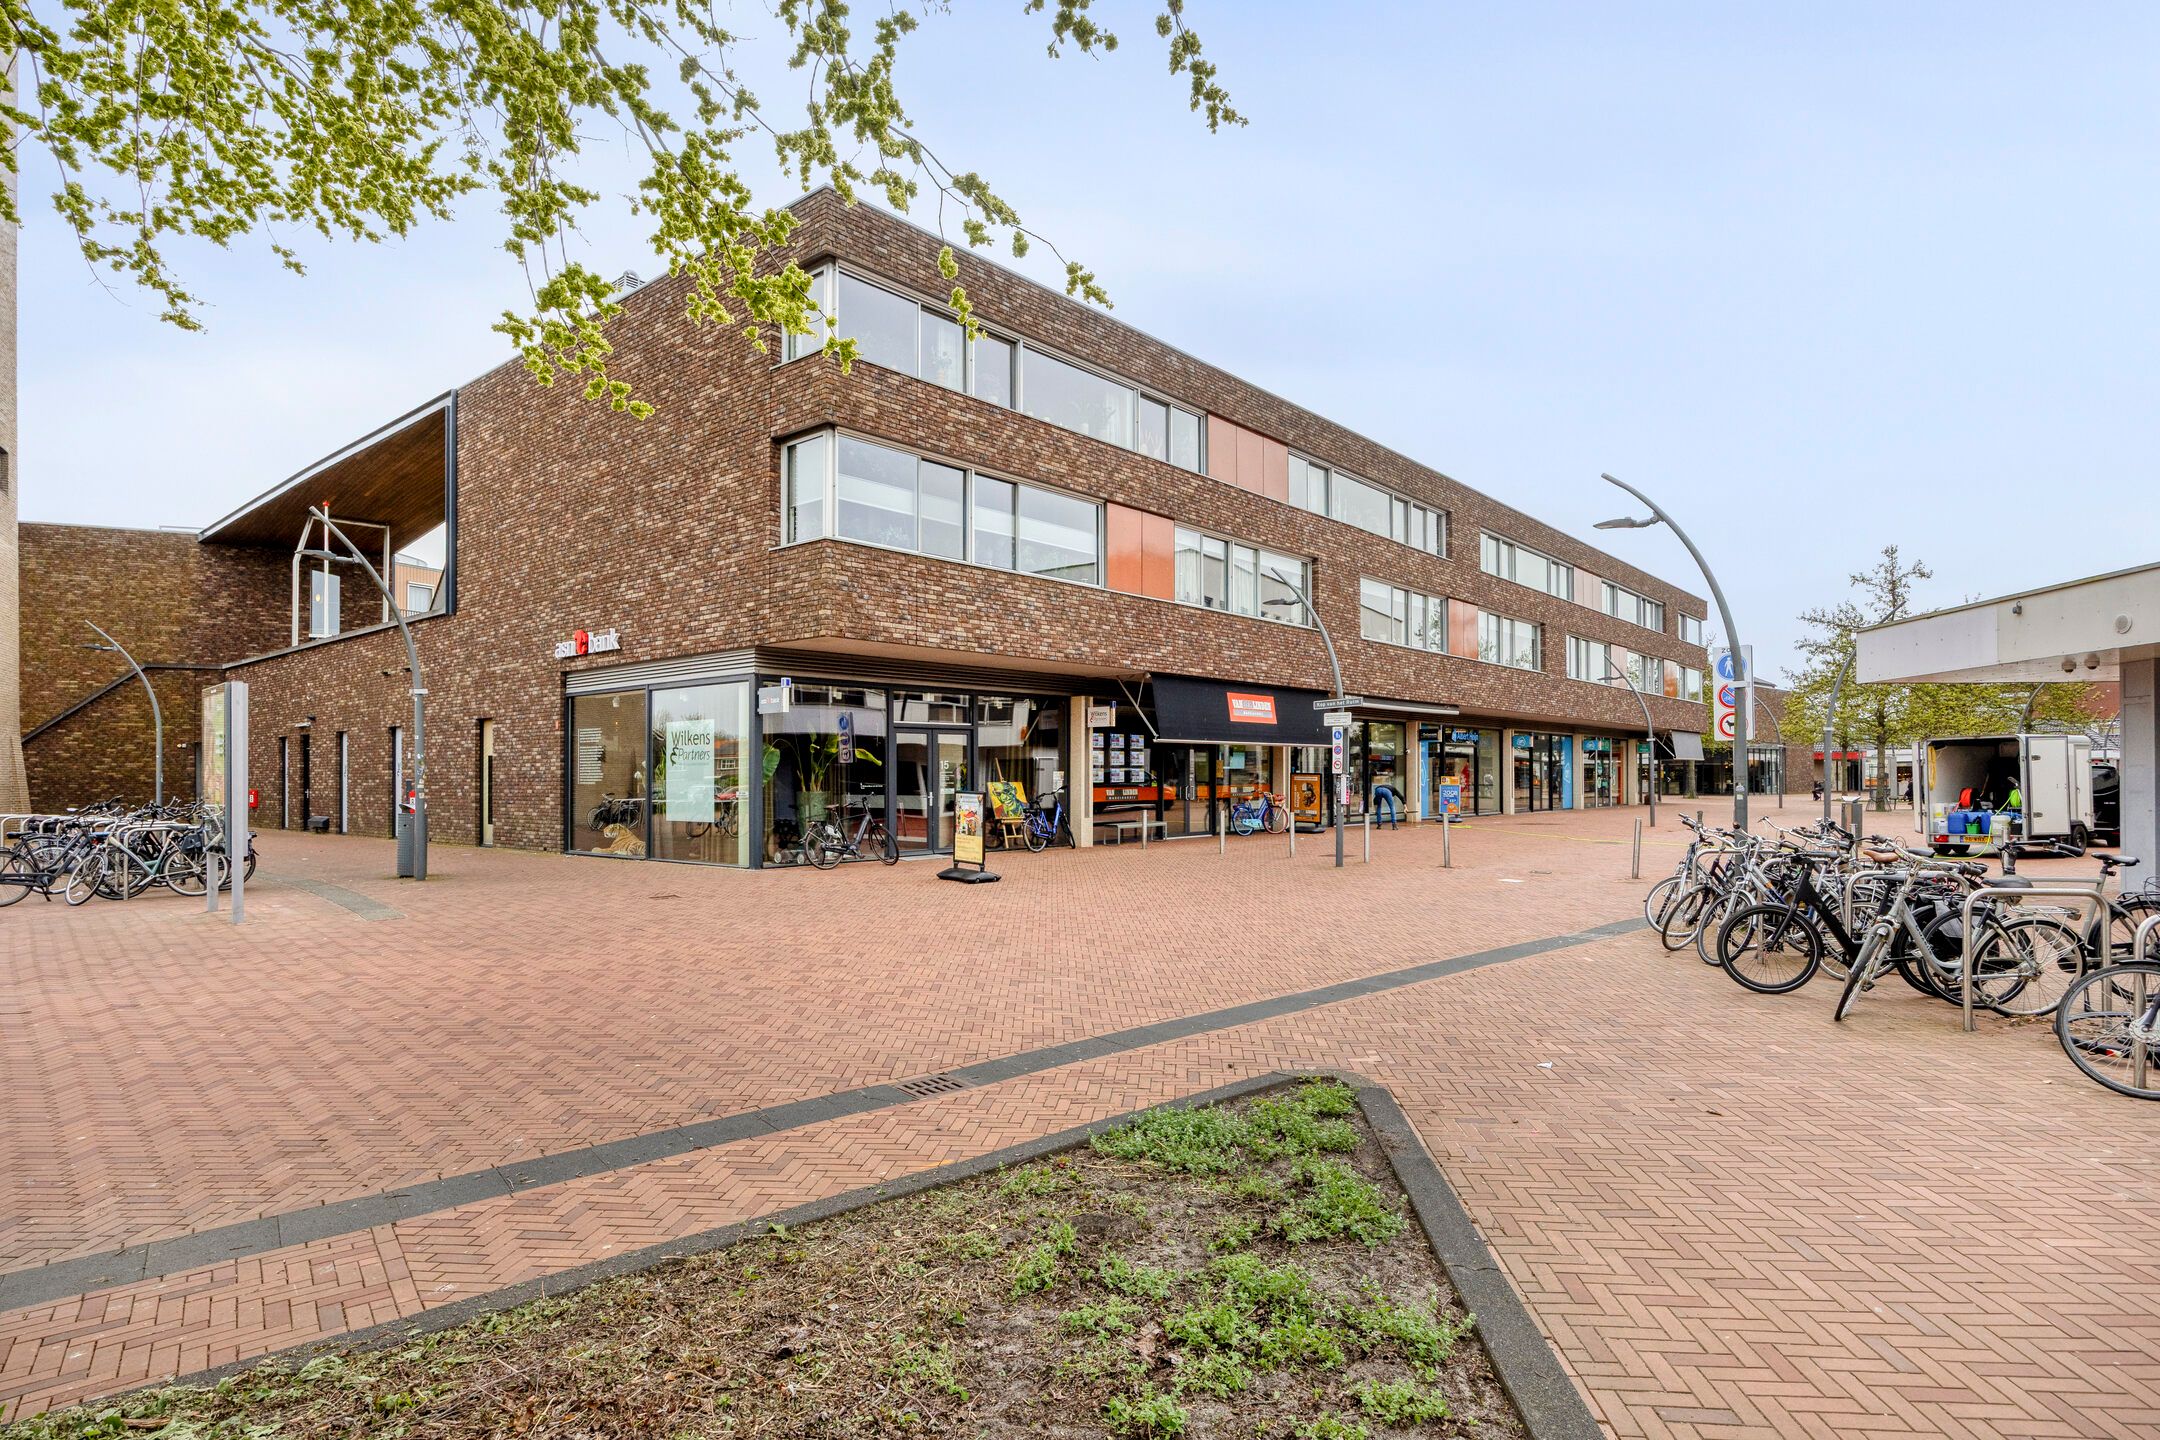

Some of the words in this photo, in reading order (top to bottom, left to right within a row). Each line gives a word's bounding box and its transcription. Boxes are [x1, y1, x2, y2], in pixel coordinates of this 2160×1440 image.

[554, 640, 577, 658] asn
[588, 628, 620, 654] bank
[671, 730, 711, 746] Wilkens
[678, 748, 711, 761] Partners
[940, 760, 950, 770] 15
